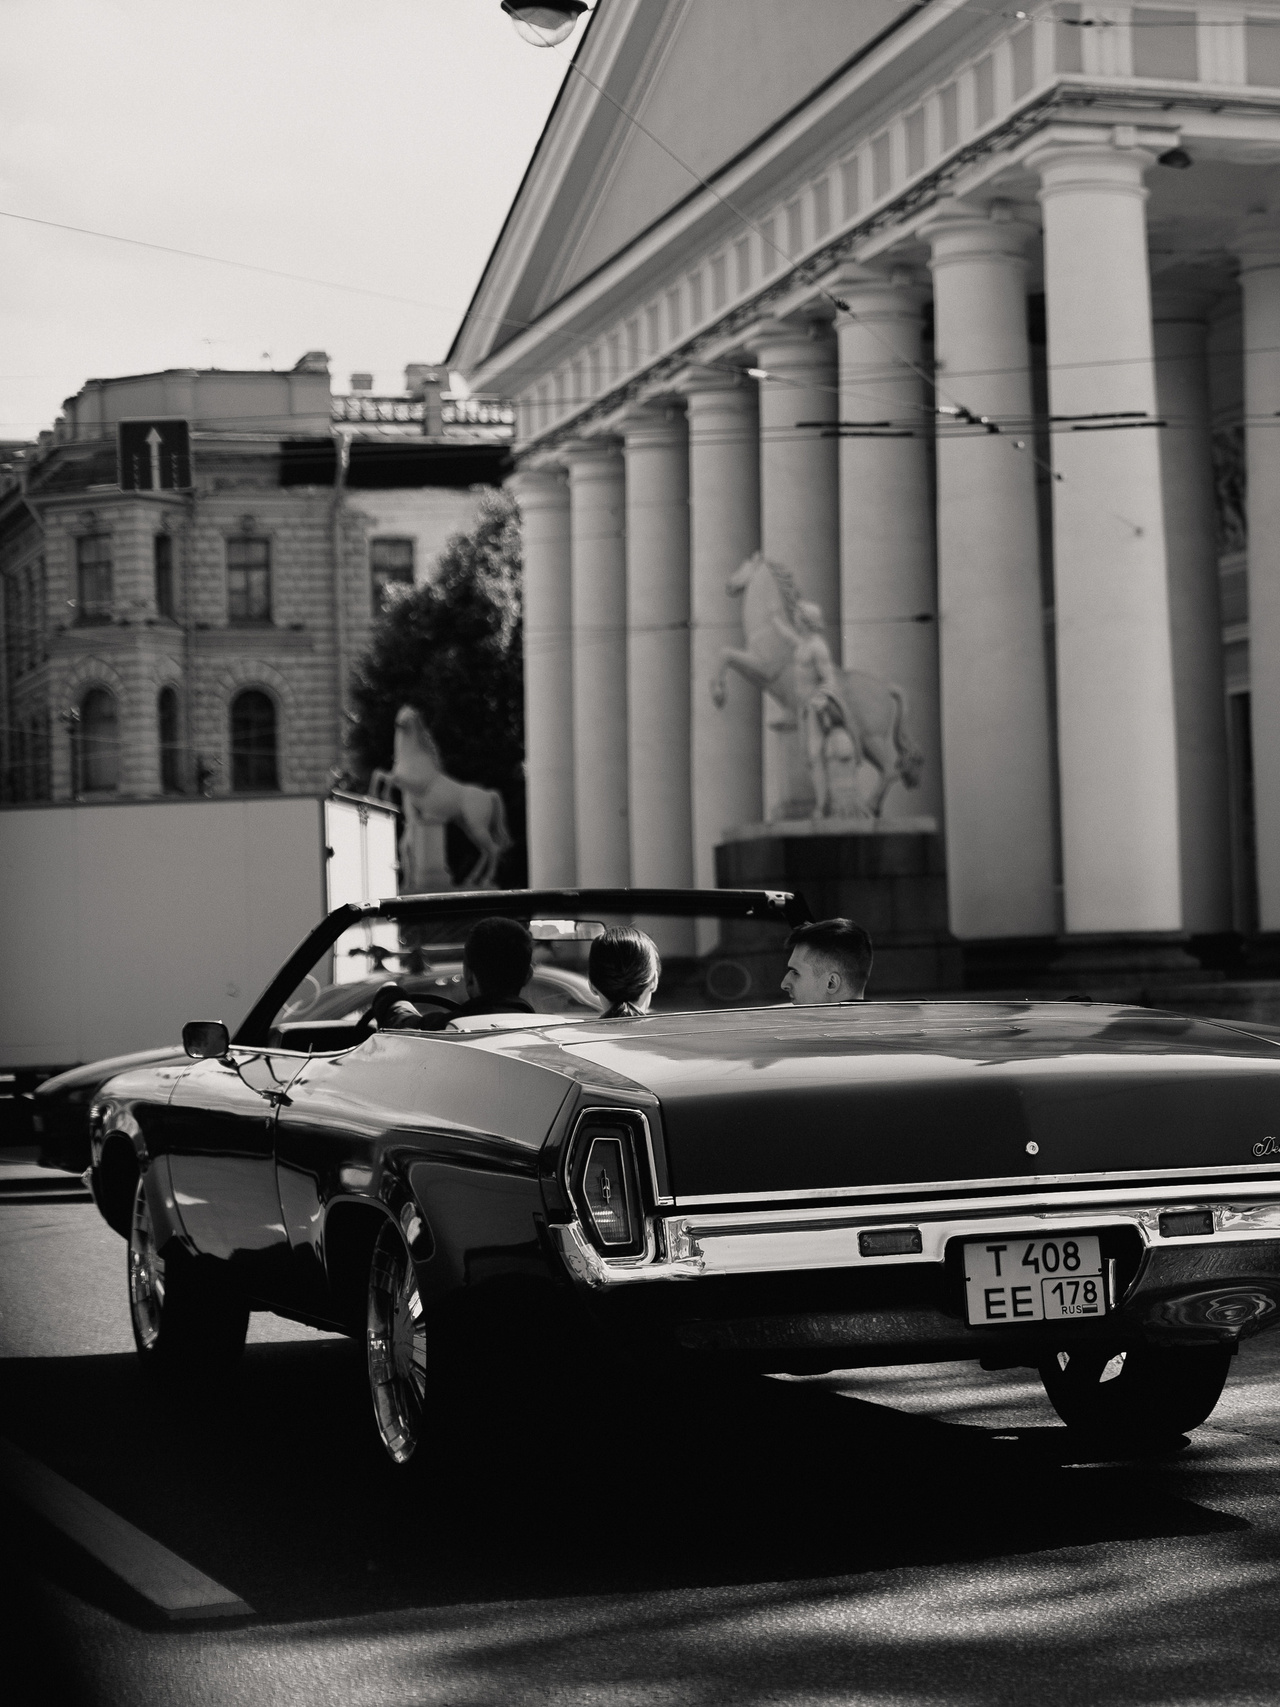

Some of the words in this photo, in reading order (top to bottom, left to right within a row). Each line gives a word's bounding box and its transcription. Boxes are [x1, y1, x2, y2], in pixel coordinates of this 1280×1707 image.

[1021, 1241, 1081, 1274] 408
[984, 1286, 1034, 1319] EE
[1051, 1280, 1098, 1306] 178
[1061, 1305, 1083, 1315] RUS
